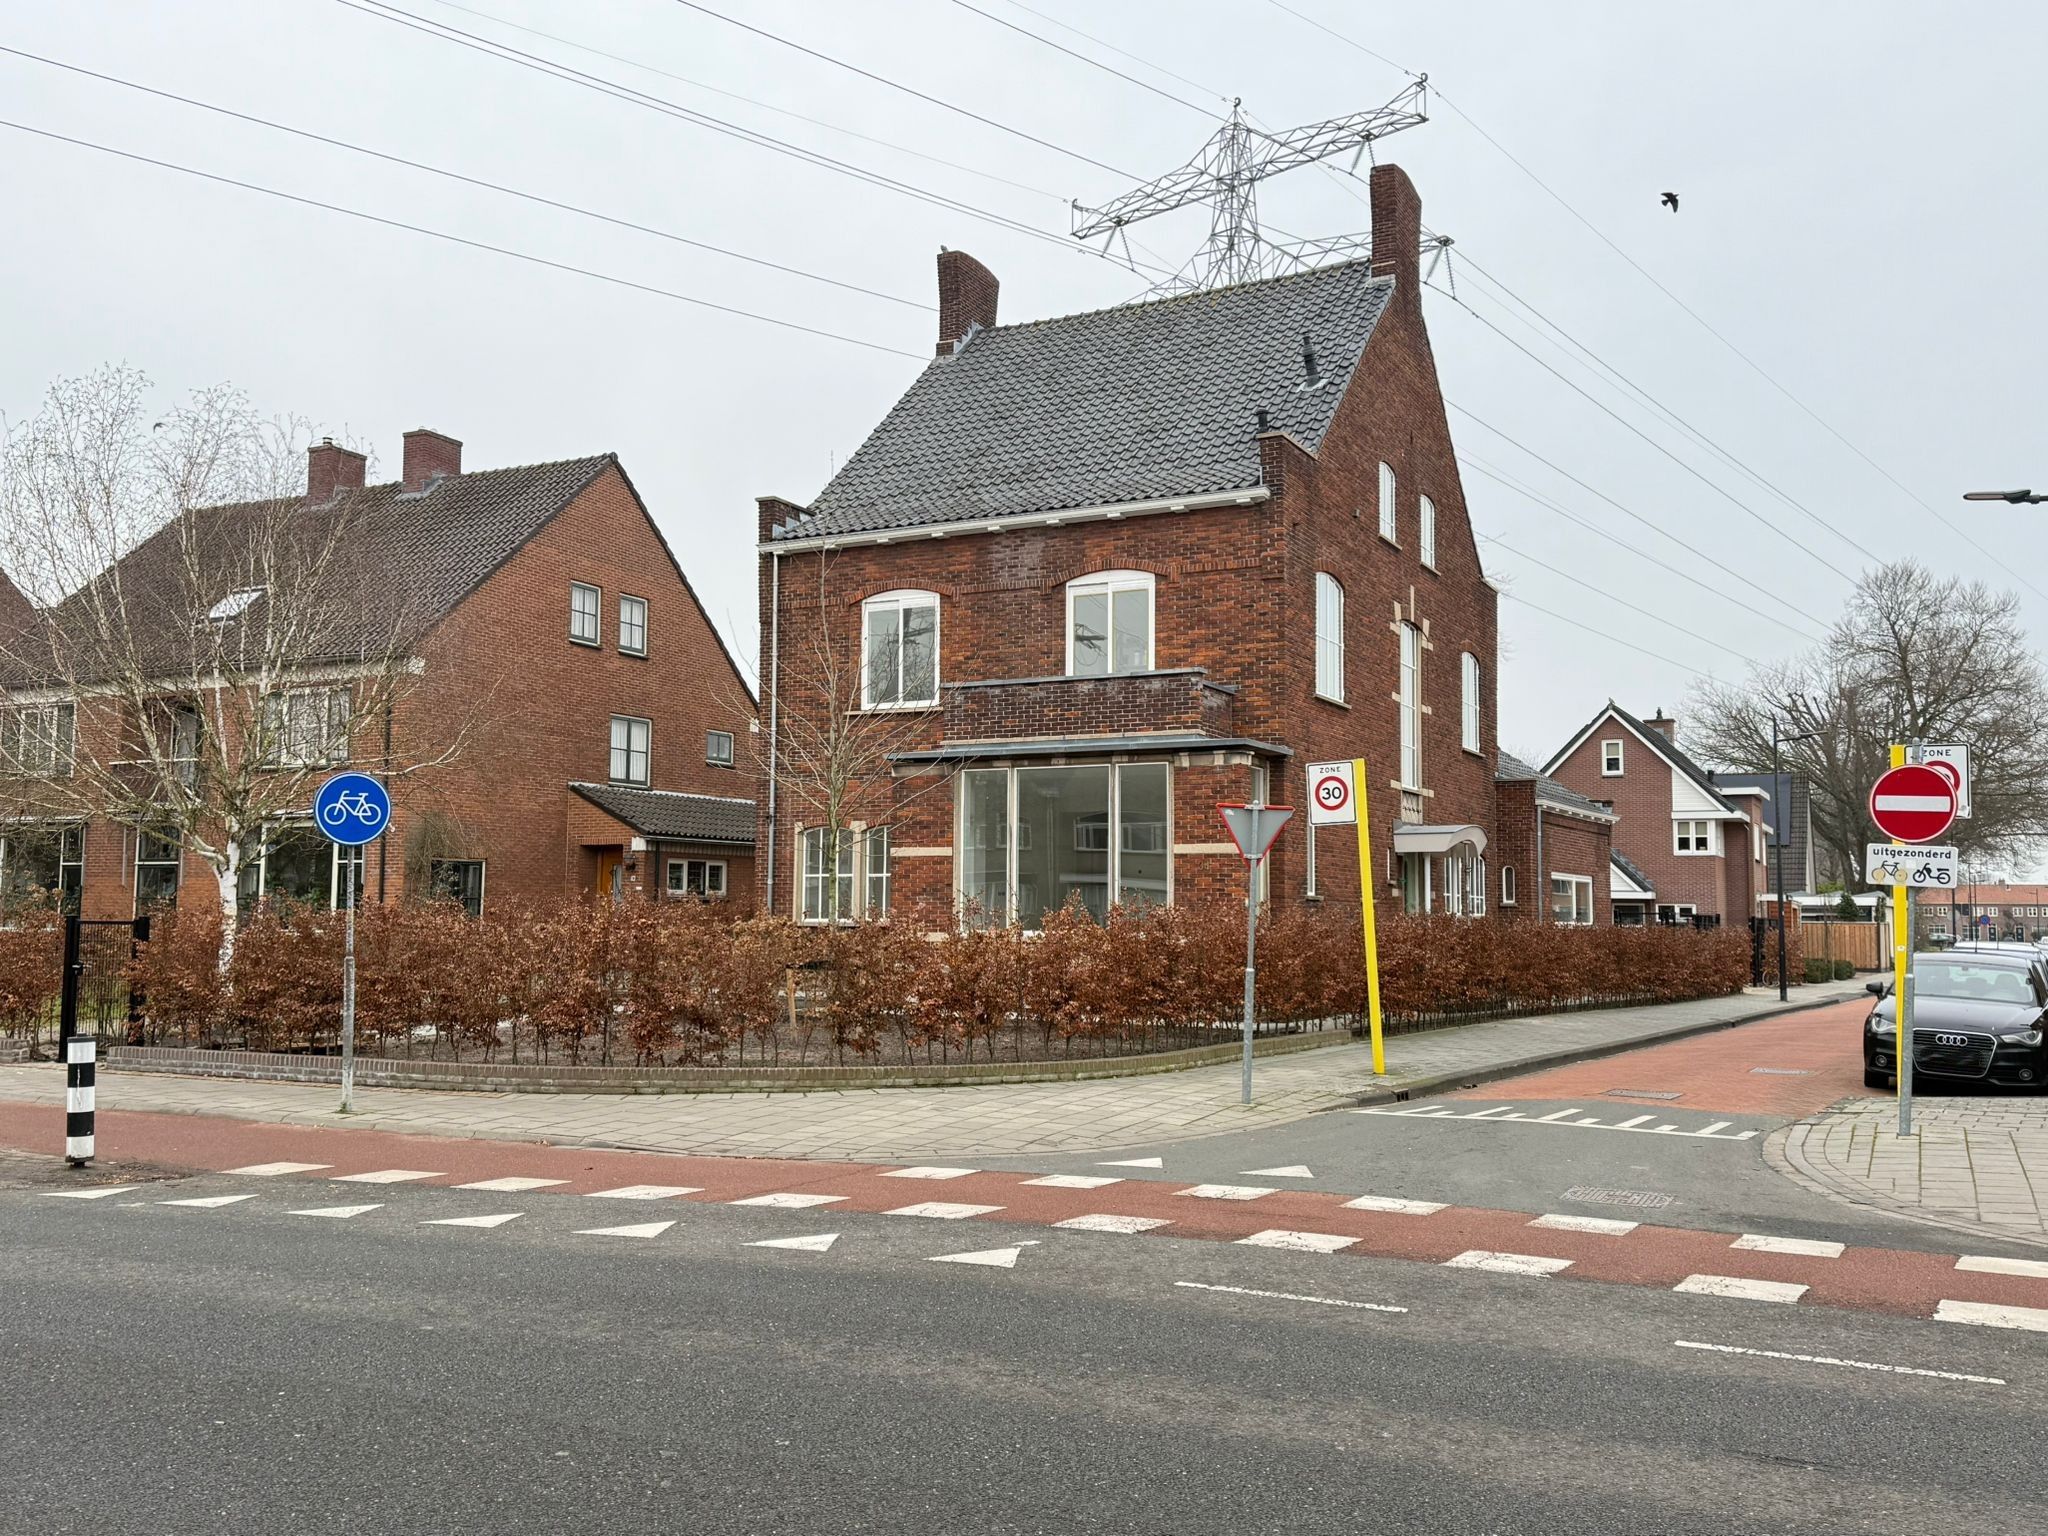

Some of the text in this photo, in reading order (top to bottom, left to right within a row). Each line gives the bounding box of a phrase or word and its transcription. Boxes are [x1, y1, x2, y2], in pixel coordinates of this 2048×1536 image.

[1922, 749, 1951, 757] ZONE
[1322, 786, 1342, 800] 30
[1873, 847, 1951, 859] uitgezonderd
